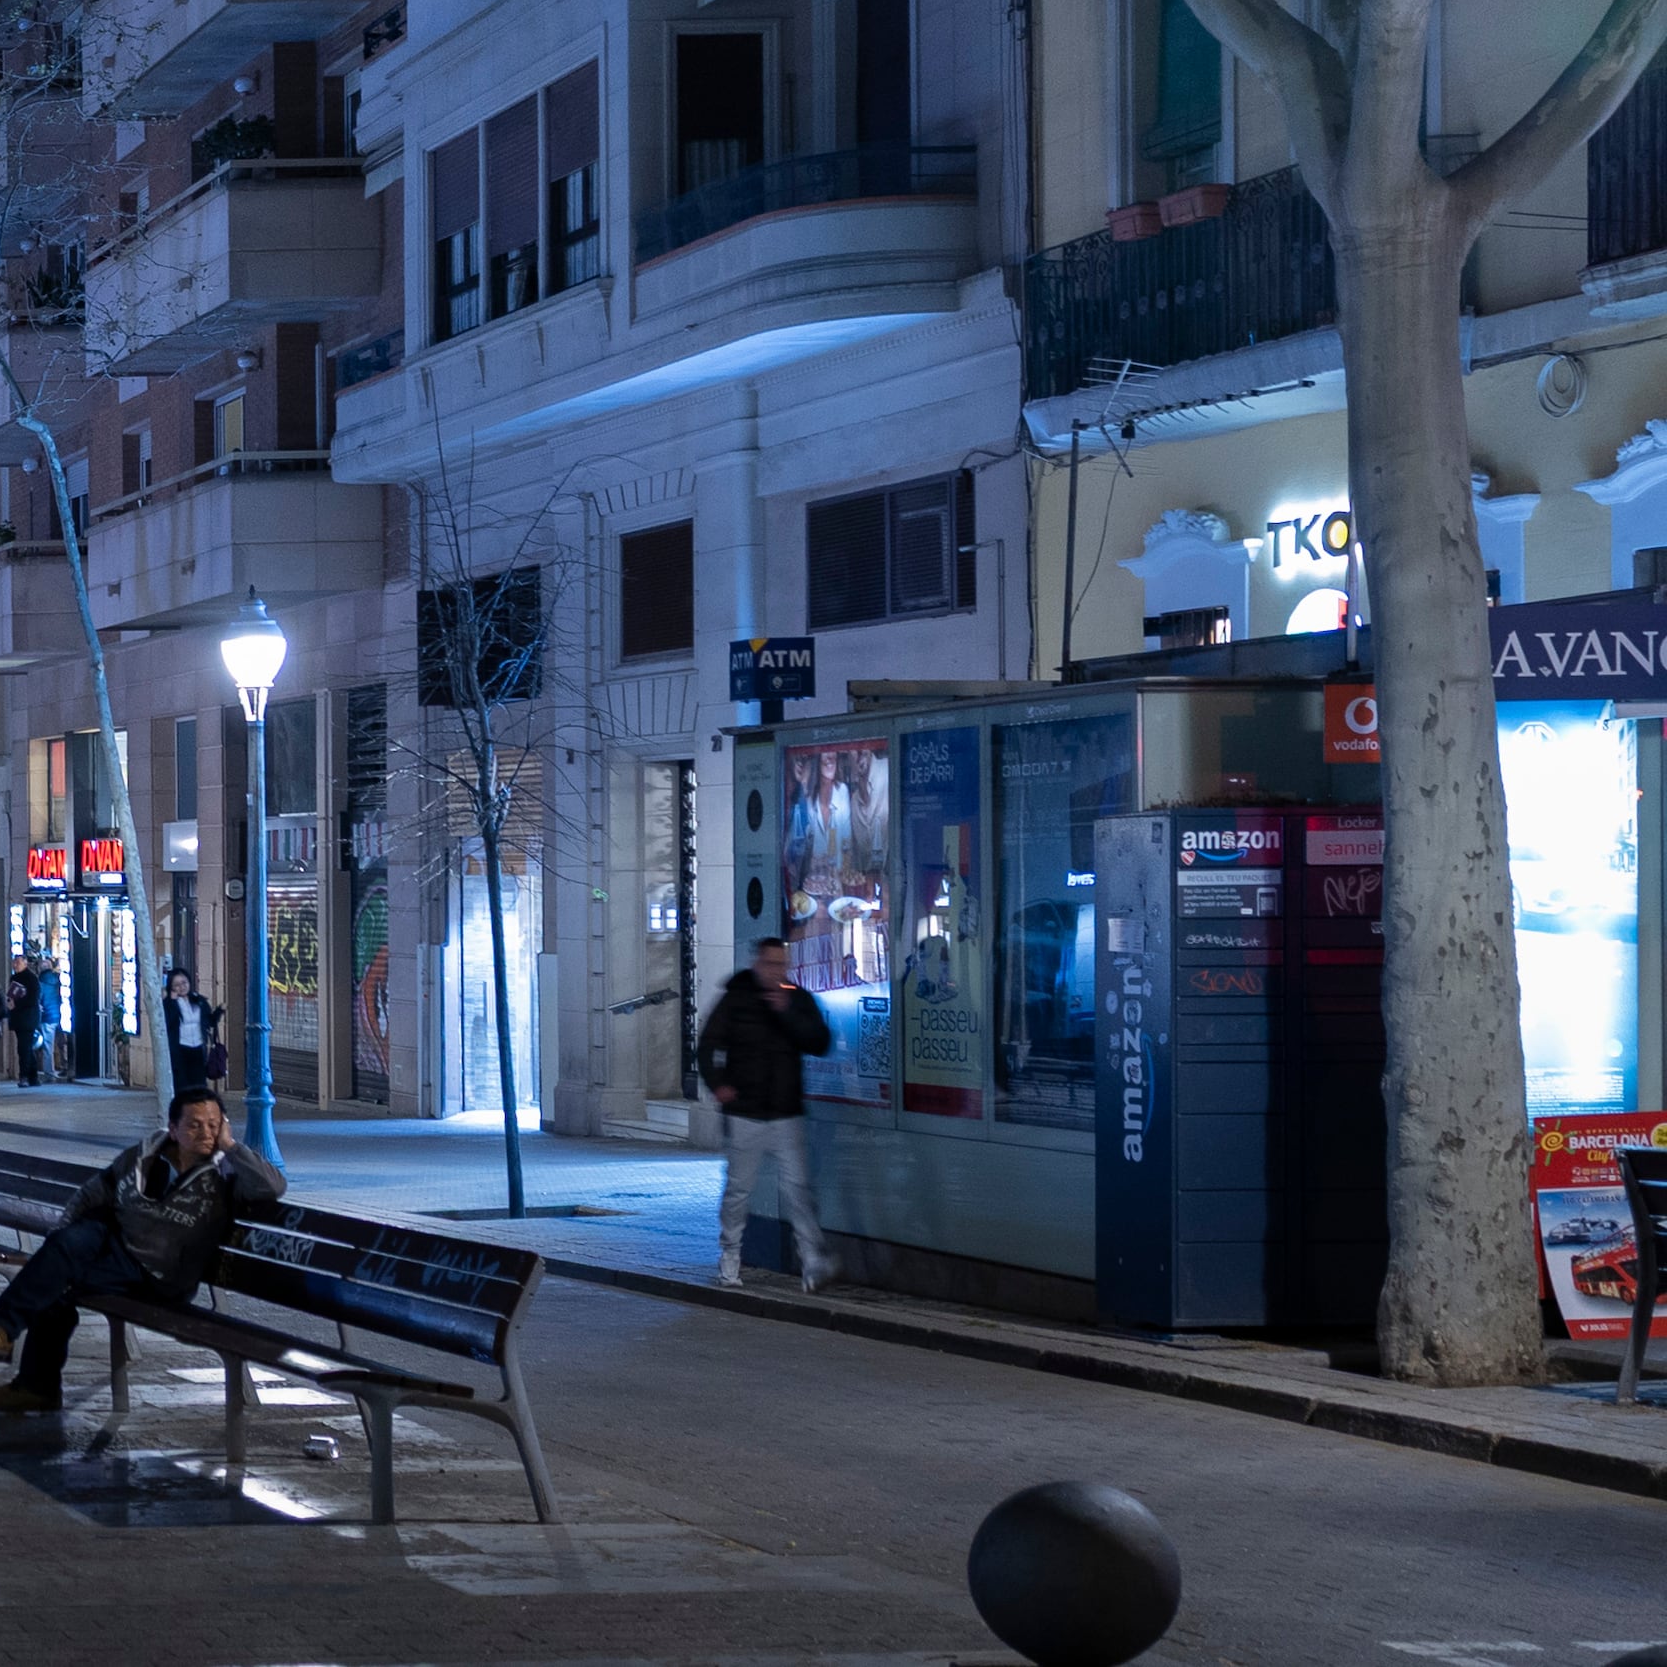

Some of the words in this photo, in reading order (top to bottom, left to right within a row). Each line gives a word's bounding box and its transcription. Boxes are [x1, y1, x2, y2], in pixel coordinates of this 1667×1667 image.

[1267, 511, 1351, 568] TKO
[731, 652, 754, 671] ATM
[758, 650, 812, 668] ATM
[1534, 629, 1667, 679] VAN
[1334, 737, 1380, 752] vodafo
[1337, 817, 1377, 829] Locker
[912, 1037, 968, 1066] passeu
[1123, 968, 1142, 1162] amazon
[1569, 1134, 1650, 1150] BARCELONA
